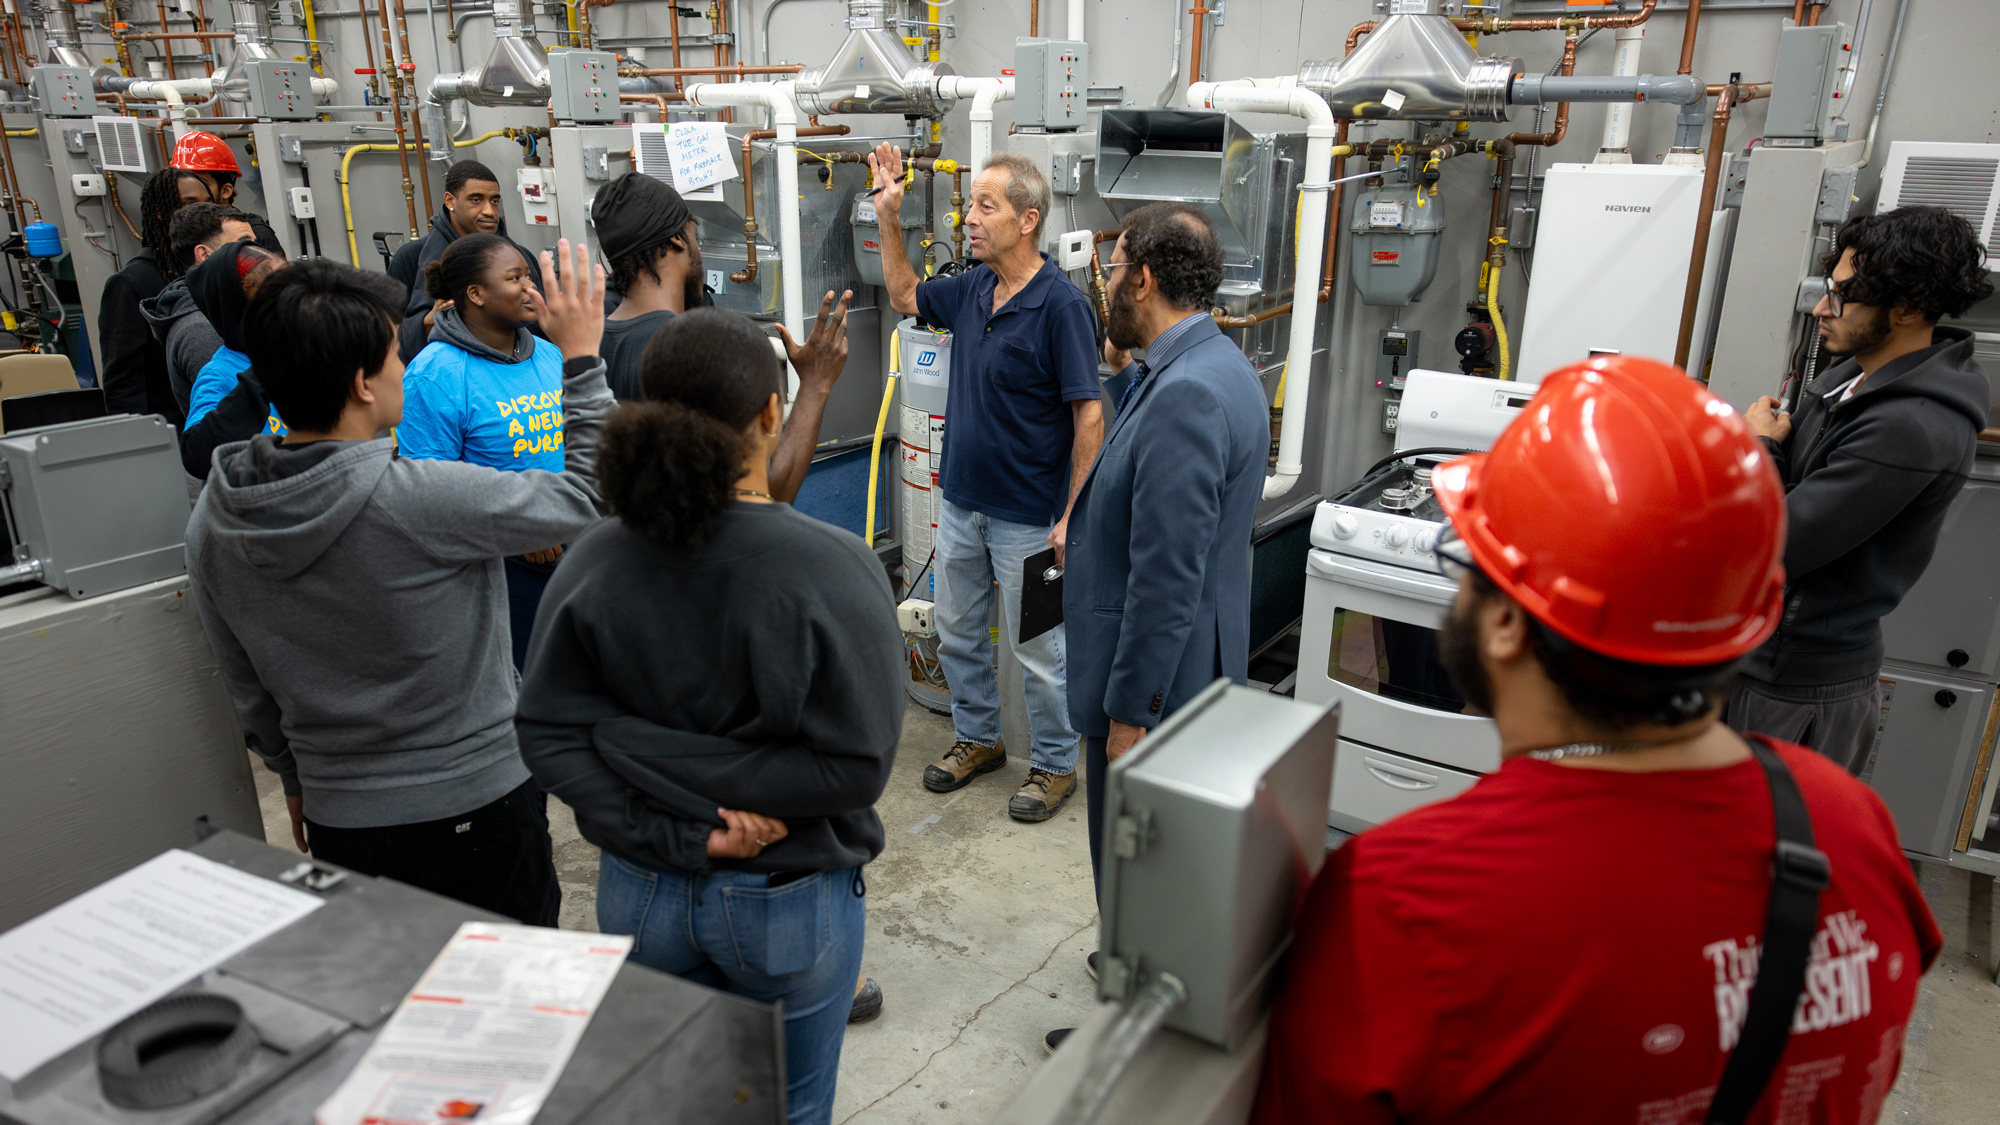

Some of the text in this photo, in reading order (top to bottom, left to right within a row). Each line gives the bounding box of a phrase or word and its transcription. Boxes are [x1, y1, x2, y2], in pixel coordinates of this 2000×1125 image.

[674, 125, 697, 138] CLOCK
[676, 132, 709, 150] THE GAS
[681, 146, 708, 162] METER
[679, 153, 723, 177] FOR FIREPLACE
[712, 273, 719, 287] 3
[913, 366, 940, 377] John Wood
[496, 389, 563, 418] DISCOV
[508, 418, 524, 438] A
[455, 821, 472, 834] CAT
